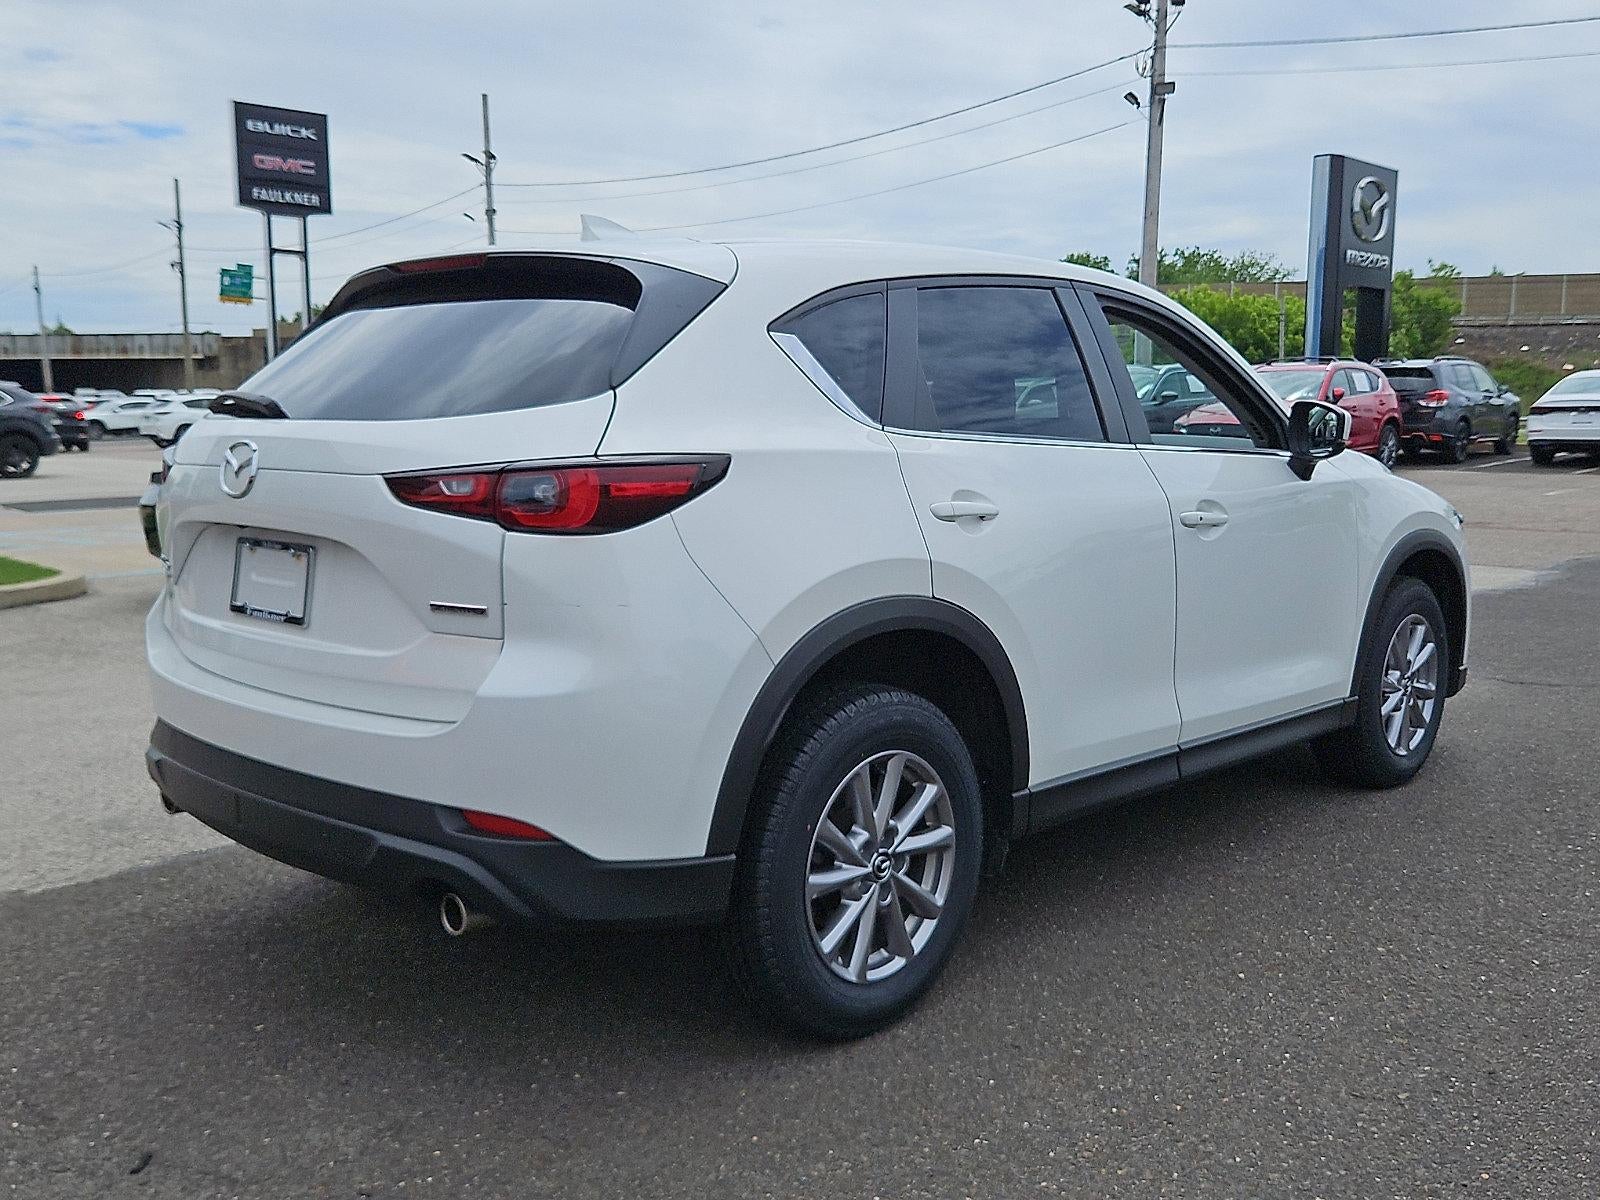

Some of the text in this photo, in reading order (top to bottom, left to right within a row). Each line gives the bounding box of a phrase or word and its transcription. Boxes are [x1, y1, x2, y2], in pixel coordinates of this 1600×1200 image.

[245, 118, 318, 141] BUICK
[253, 153, 316, 175] GMC
[252, 186, 320, 207] FAULKNER
